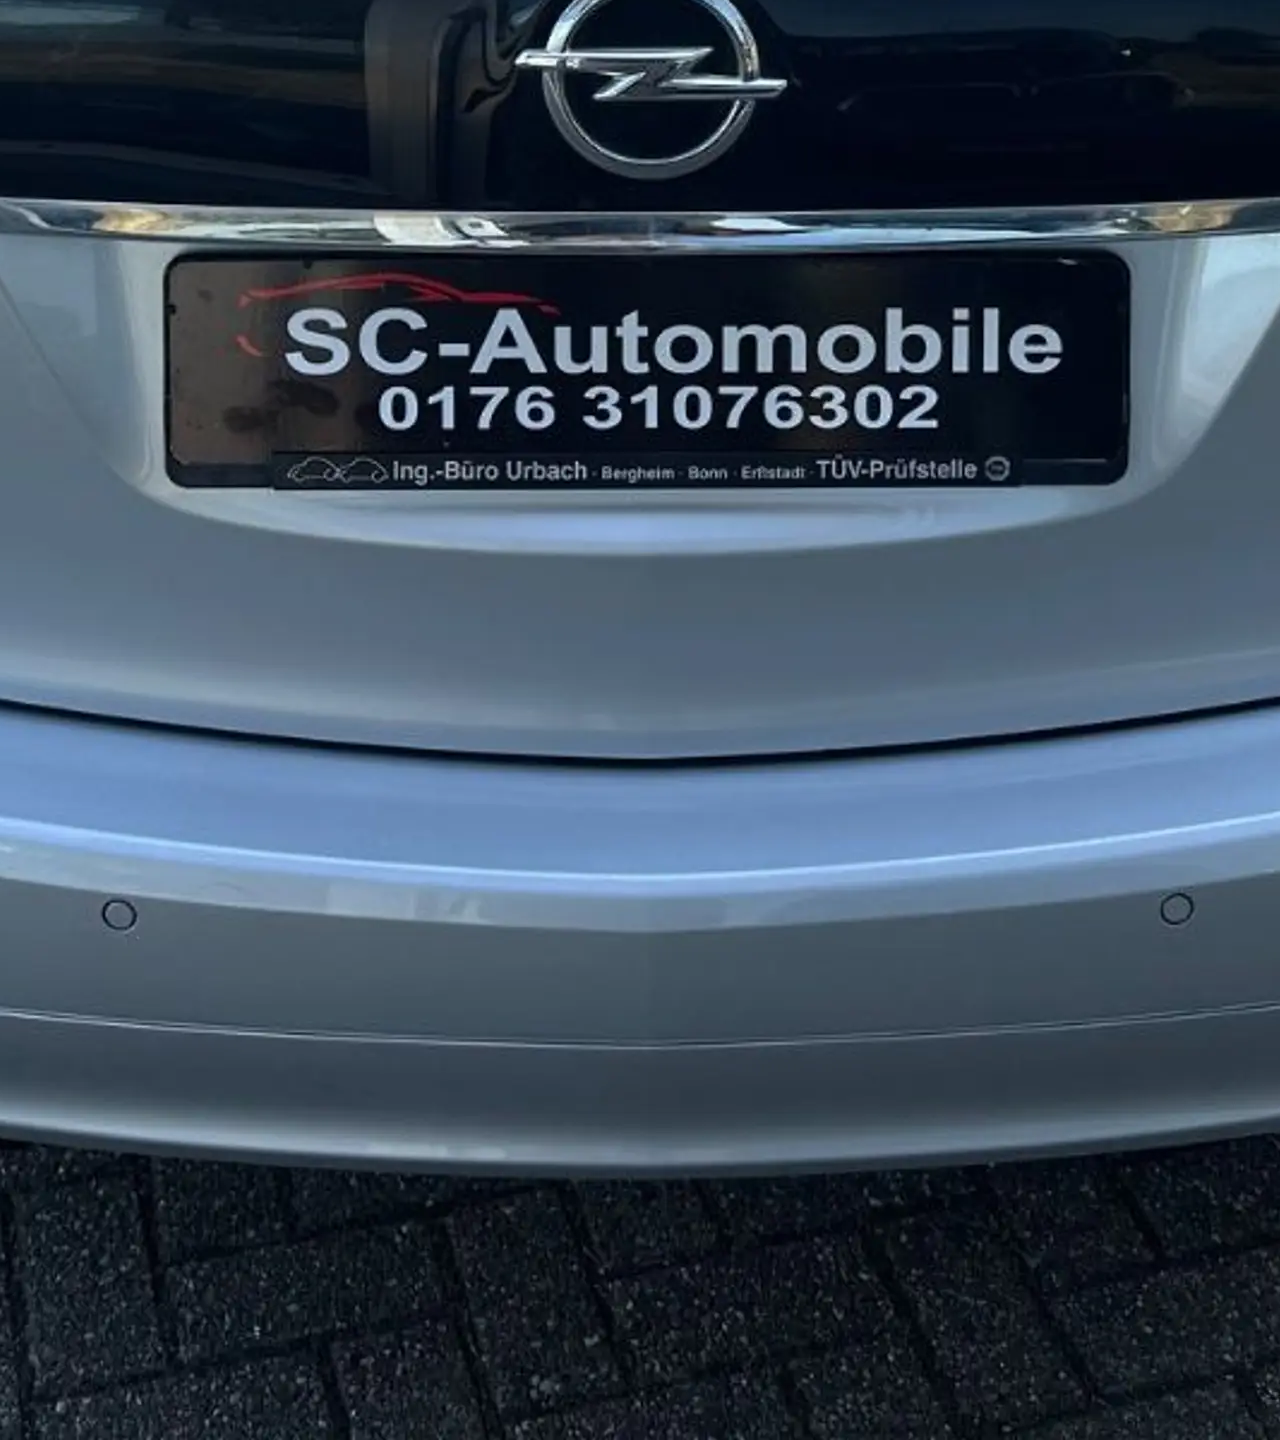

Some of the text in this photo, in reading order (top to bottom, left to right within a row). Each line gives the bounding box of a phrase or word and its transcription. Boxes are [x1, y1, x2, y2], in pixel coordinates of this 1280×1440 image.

[285, 306, 1064, 377] SC-Automobile
[378, 384, 939, 431] 0176 31076302
[392, 460, 499, 485] Ing.-Büro
[505, 460, 588, 480] Urbach
[601, 466, 675, 484] Bergheim
[687, 466, 728, 480] Bonn
[815, 454, 978, 481] TÜV-Prüfstelle
